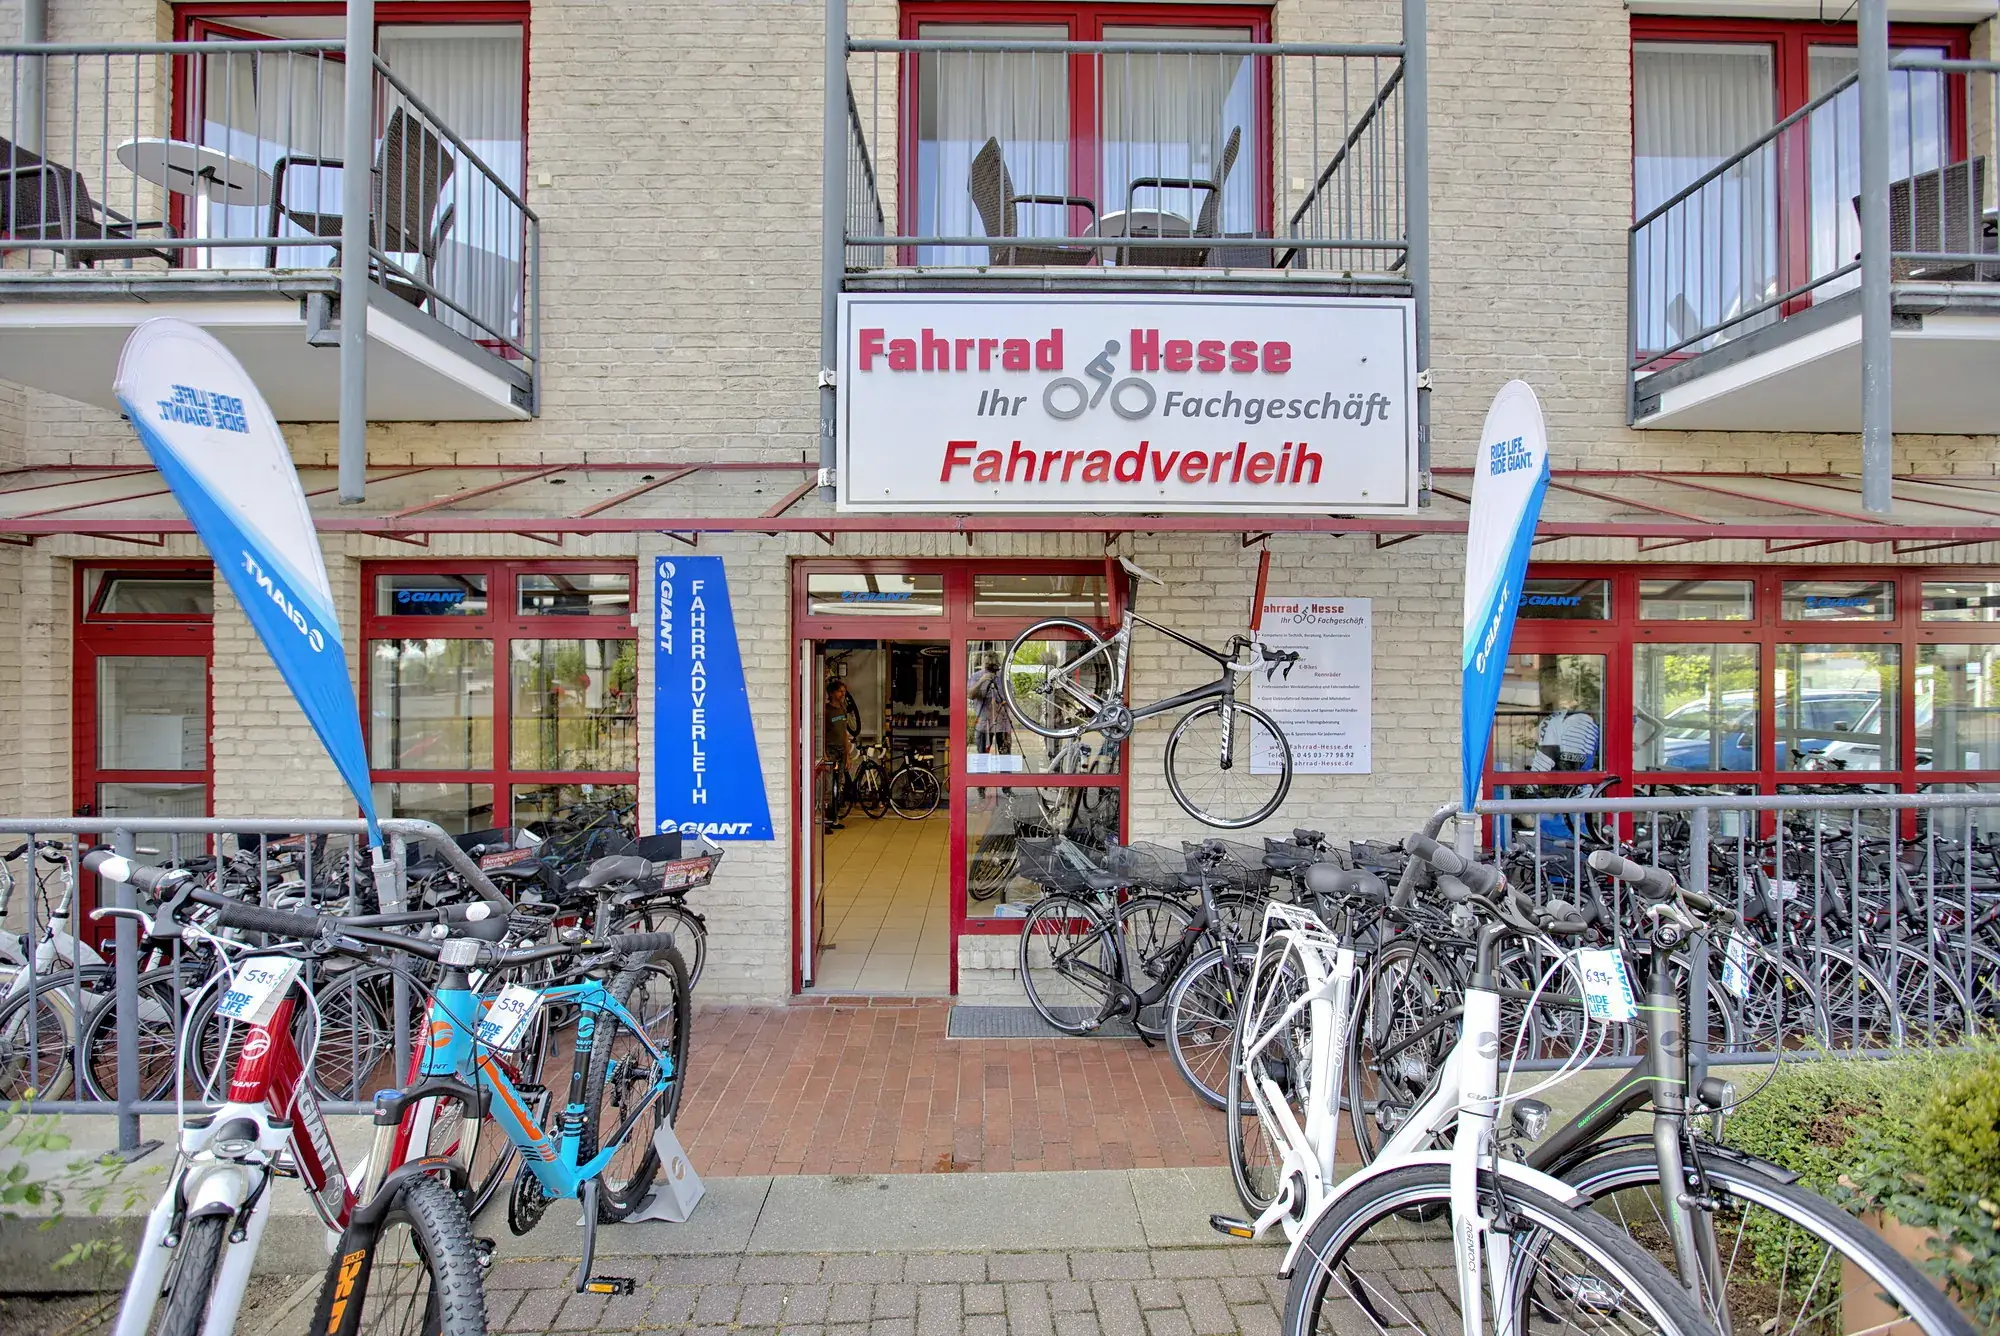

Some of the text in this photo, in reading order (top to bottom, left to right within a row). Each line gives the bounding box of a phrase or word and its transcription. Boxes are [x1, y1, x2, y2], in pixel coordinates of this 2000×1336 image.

[858, 328, 1292, 374] Fahrrad Hesse
[977, 389, 1391, 425] Ihr Fachgeschäft
[1490, 442, 1506, 460] RIDE
[940, 440, 1324, 485] Fahrradverleih
[1490, 457, 1507, 476] RIDE
[411, 592, 465, 602] GIANT
[855, 592, 912, 601] GIANT
[1529, 595, 1582, 606] GIANT
[1263, 604, 1344, 613] ahrrad Hesse
[660, 580, 673, 654] GIANT
[690, 580, 706, 804] FAHRRADVERLEIH
[679, 822, 752, 835] GIANT
[224, 990, 254, 1004] RIDE
[1587, 994, 1609, 1004] RIDE
[219, 1000, 245, 1013] LIFE
[1589, 1004, 1609, 1014] LIFE
[480, 1020, 503, 1034] RIDE
[298, 1092, 337, 1171] GIANT
